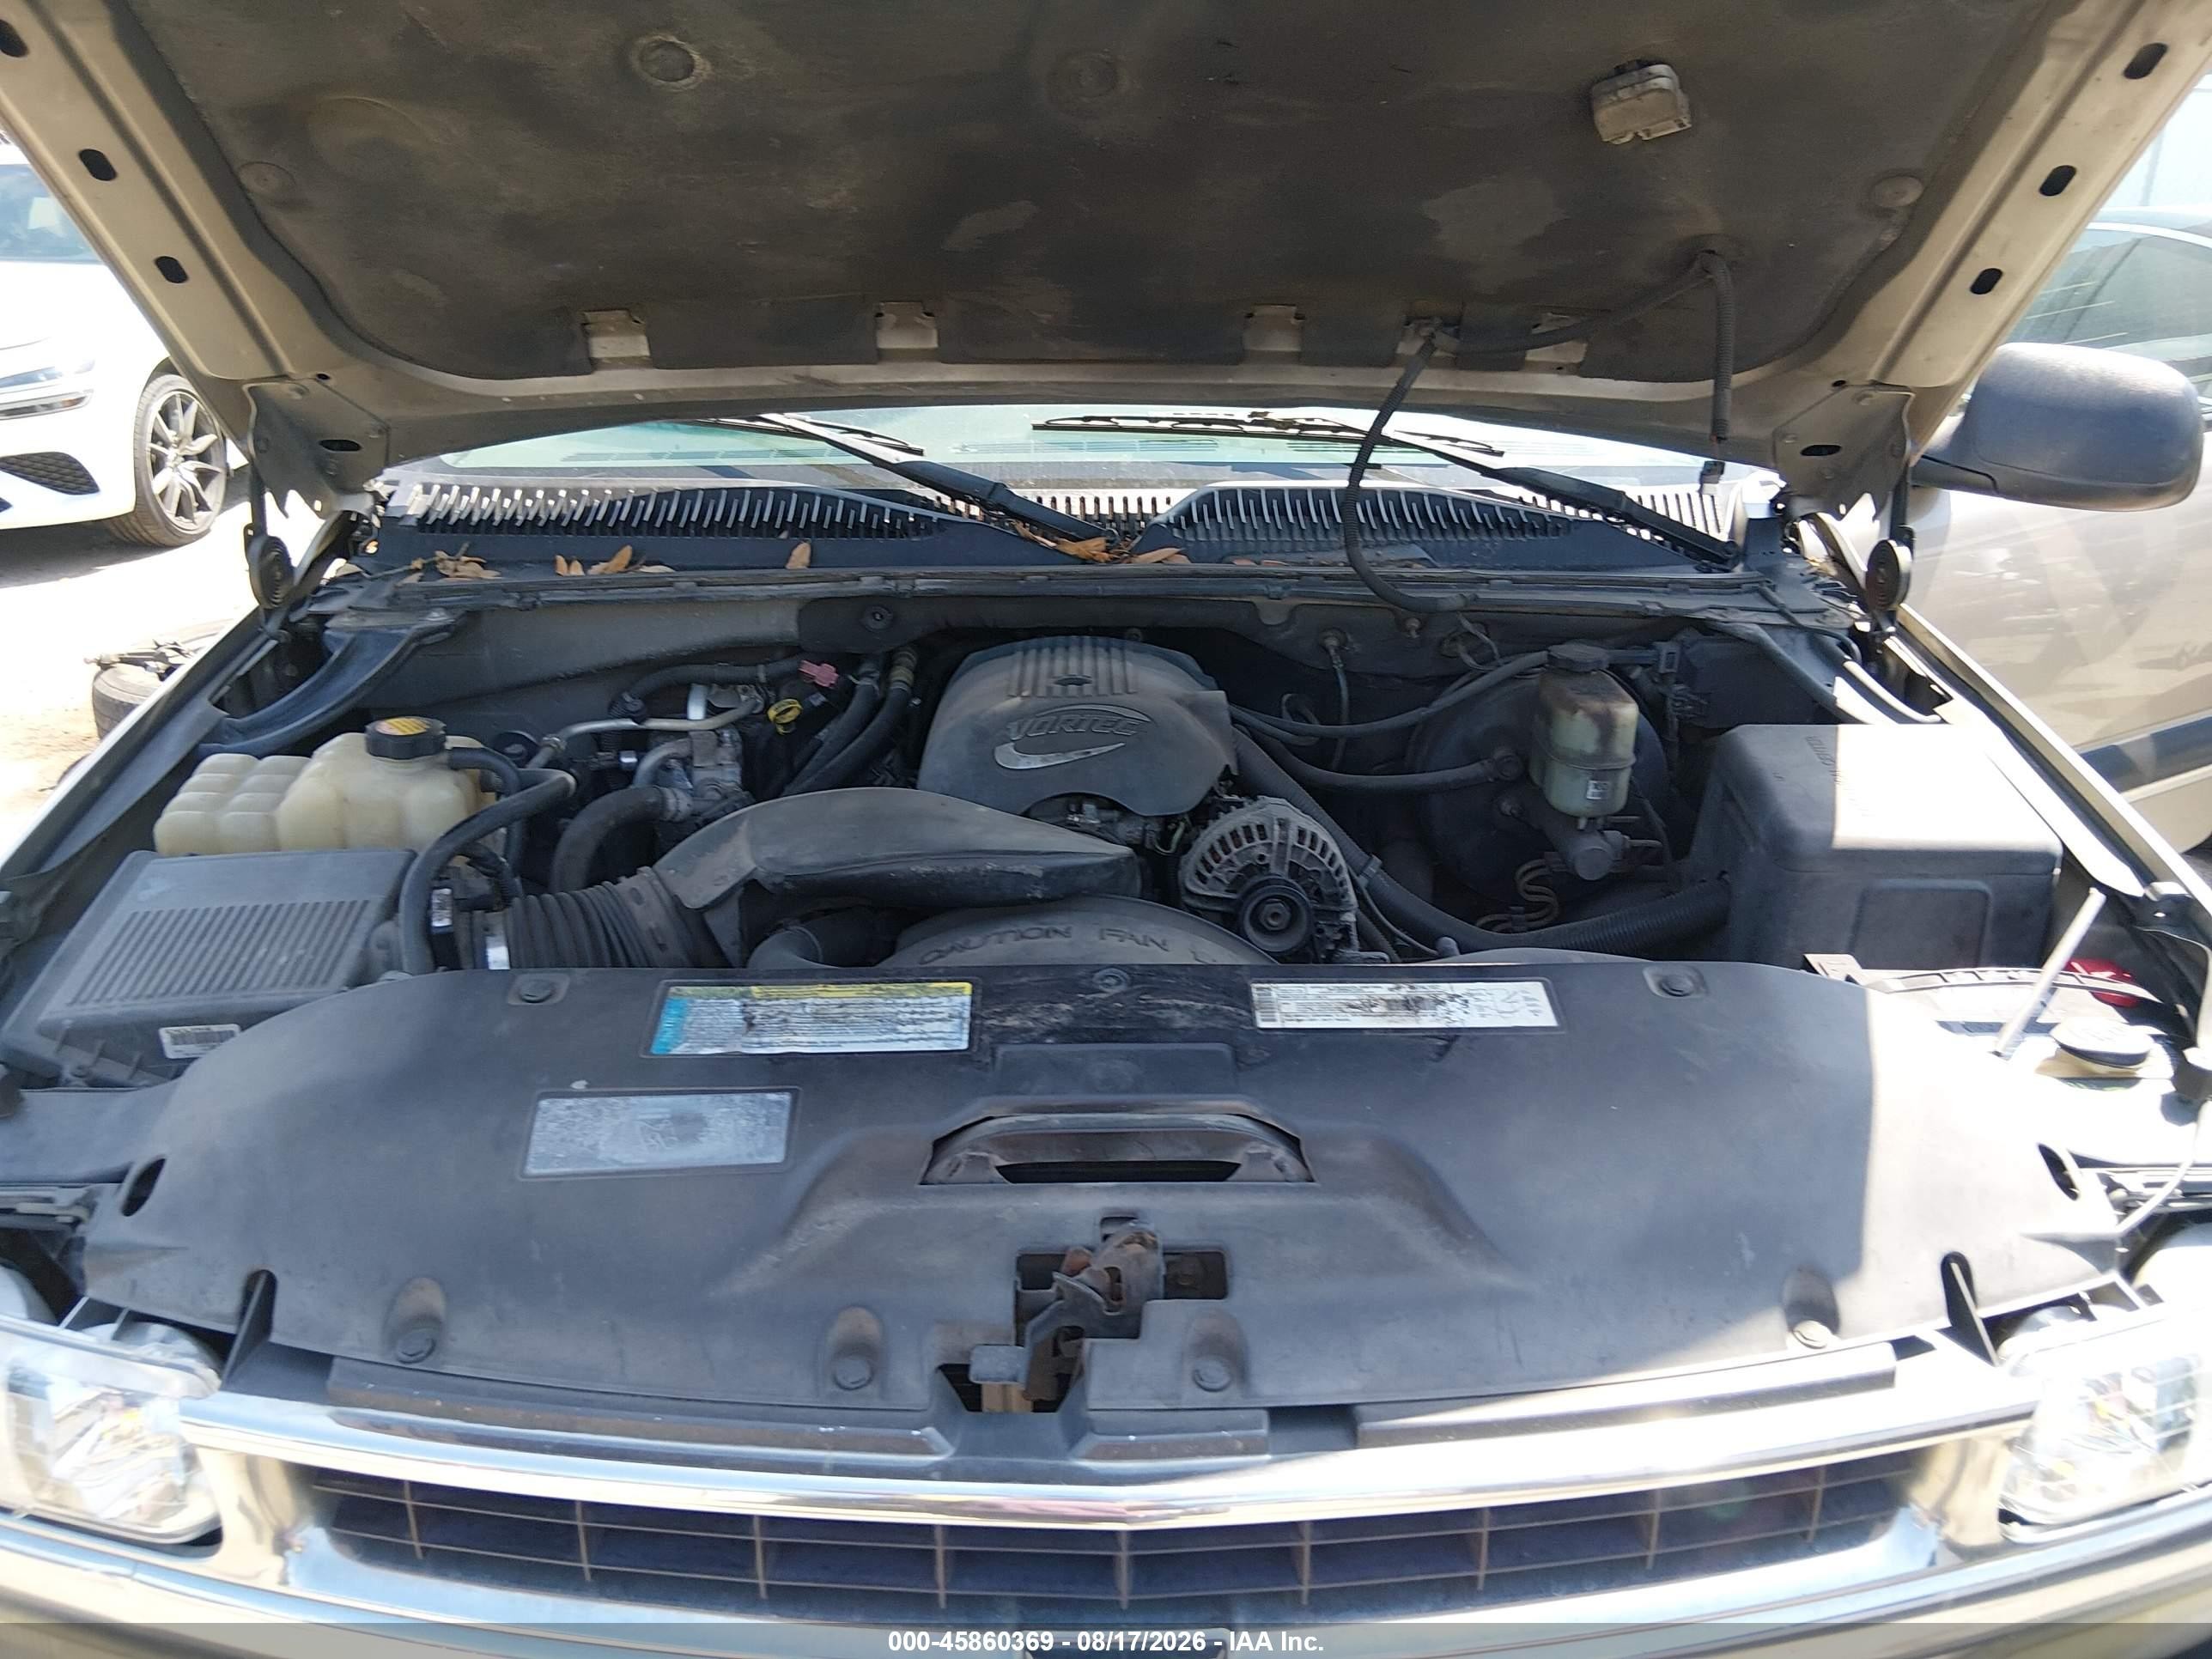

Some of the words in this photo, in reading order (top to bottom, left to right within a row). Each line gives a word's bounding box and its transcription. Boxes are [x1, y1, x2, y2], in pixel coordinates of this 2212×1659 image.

[1006, 714, 1142, 741] VORTEC
[919, 927, 1073, 965] CAUTION
[1099, 927, 1170, 952] FAN
